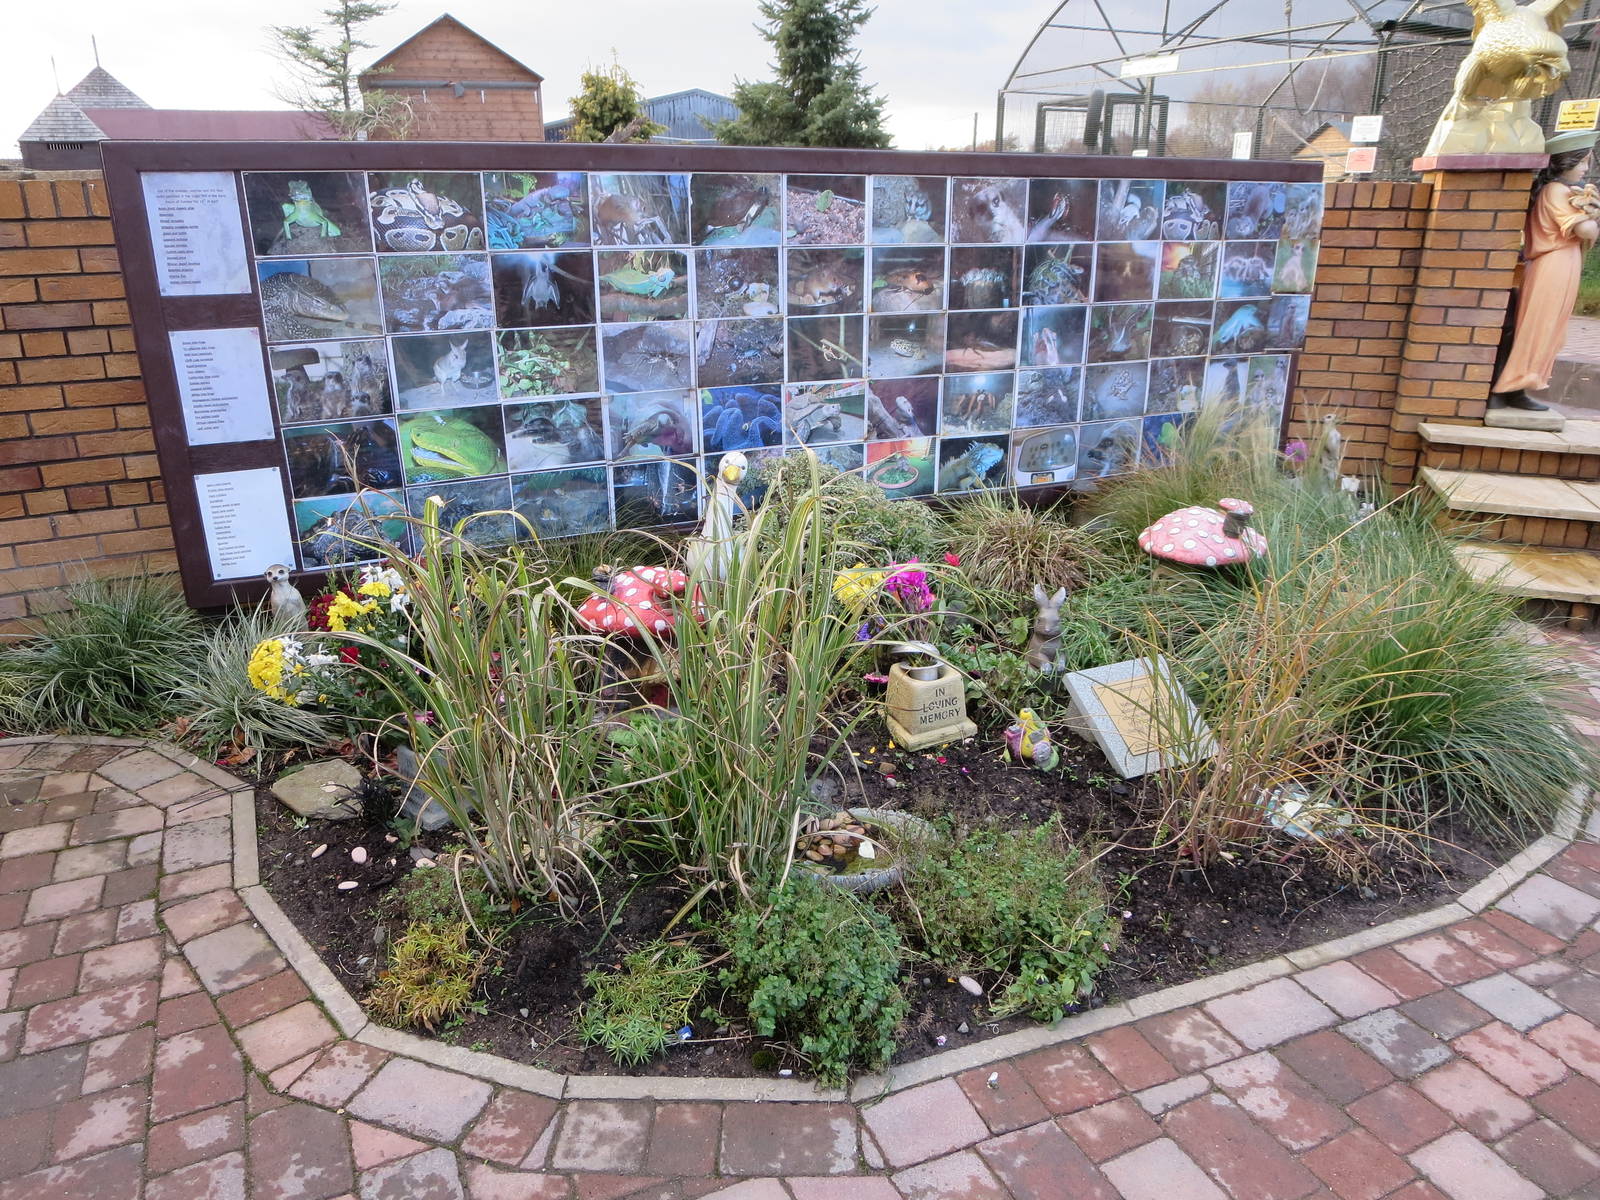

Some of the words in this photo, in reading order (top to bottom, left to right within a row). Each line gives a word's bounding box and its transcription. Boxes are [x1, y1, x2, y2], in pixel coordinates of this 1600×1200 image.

[935, 687, 945, 697] IN
[923, 697, 958, 712] LOVING
[920, 708, 960, 724] MEMORY
